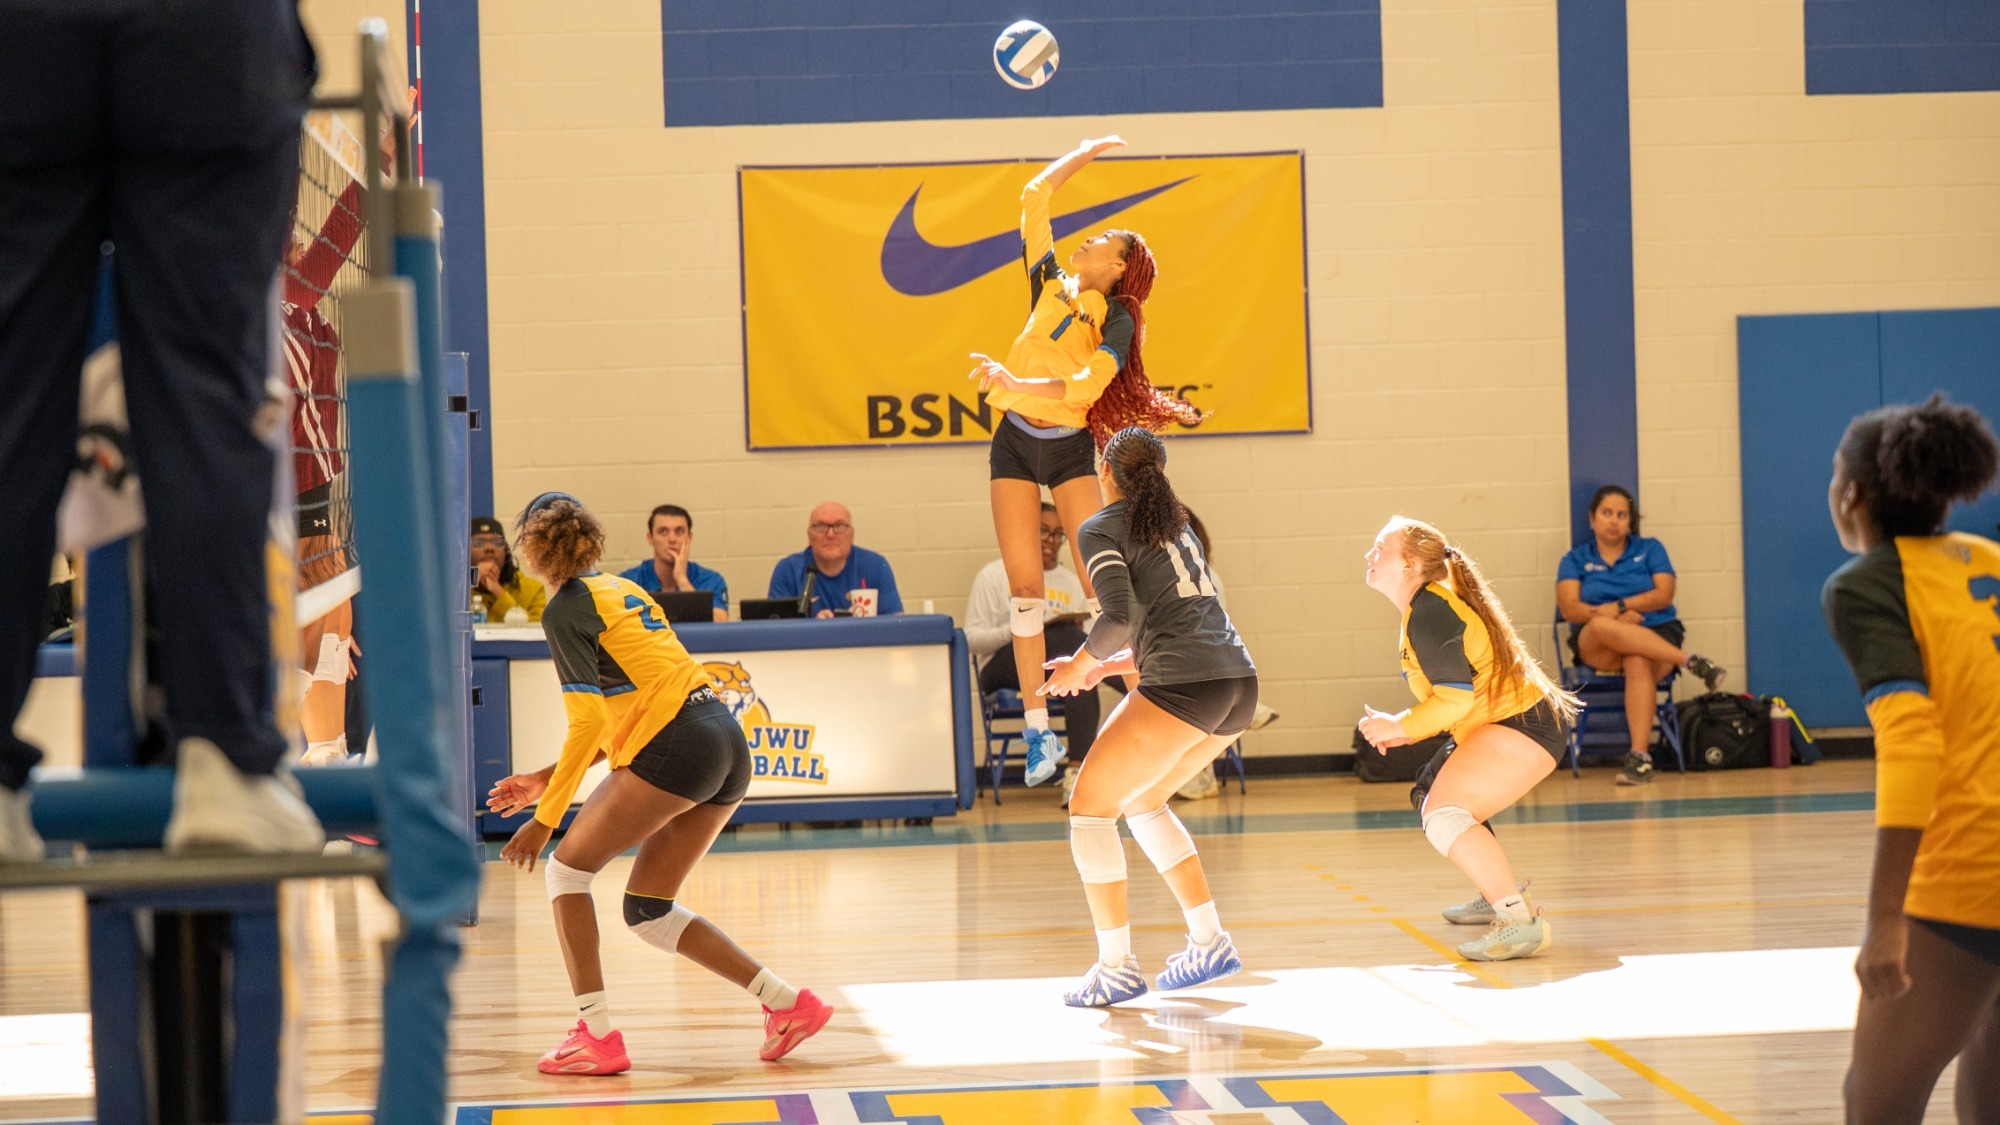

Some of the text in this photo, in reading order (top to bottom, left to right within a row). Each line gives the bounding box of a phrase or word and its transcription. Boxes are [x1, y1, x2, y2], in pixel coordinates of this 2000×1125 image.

[1050, 314, 1073, 341] 1
[867, 391, 992, 438] BSN
[1160, 532, 1218, 598] 11
[624, 594, 667, 632] 2
[748, 727, 809, 750] JWU
